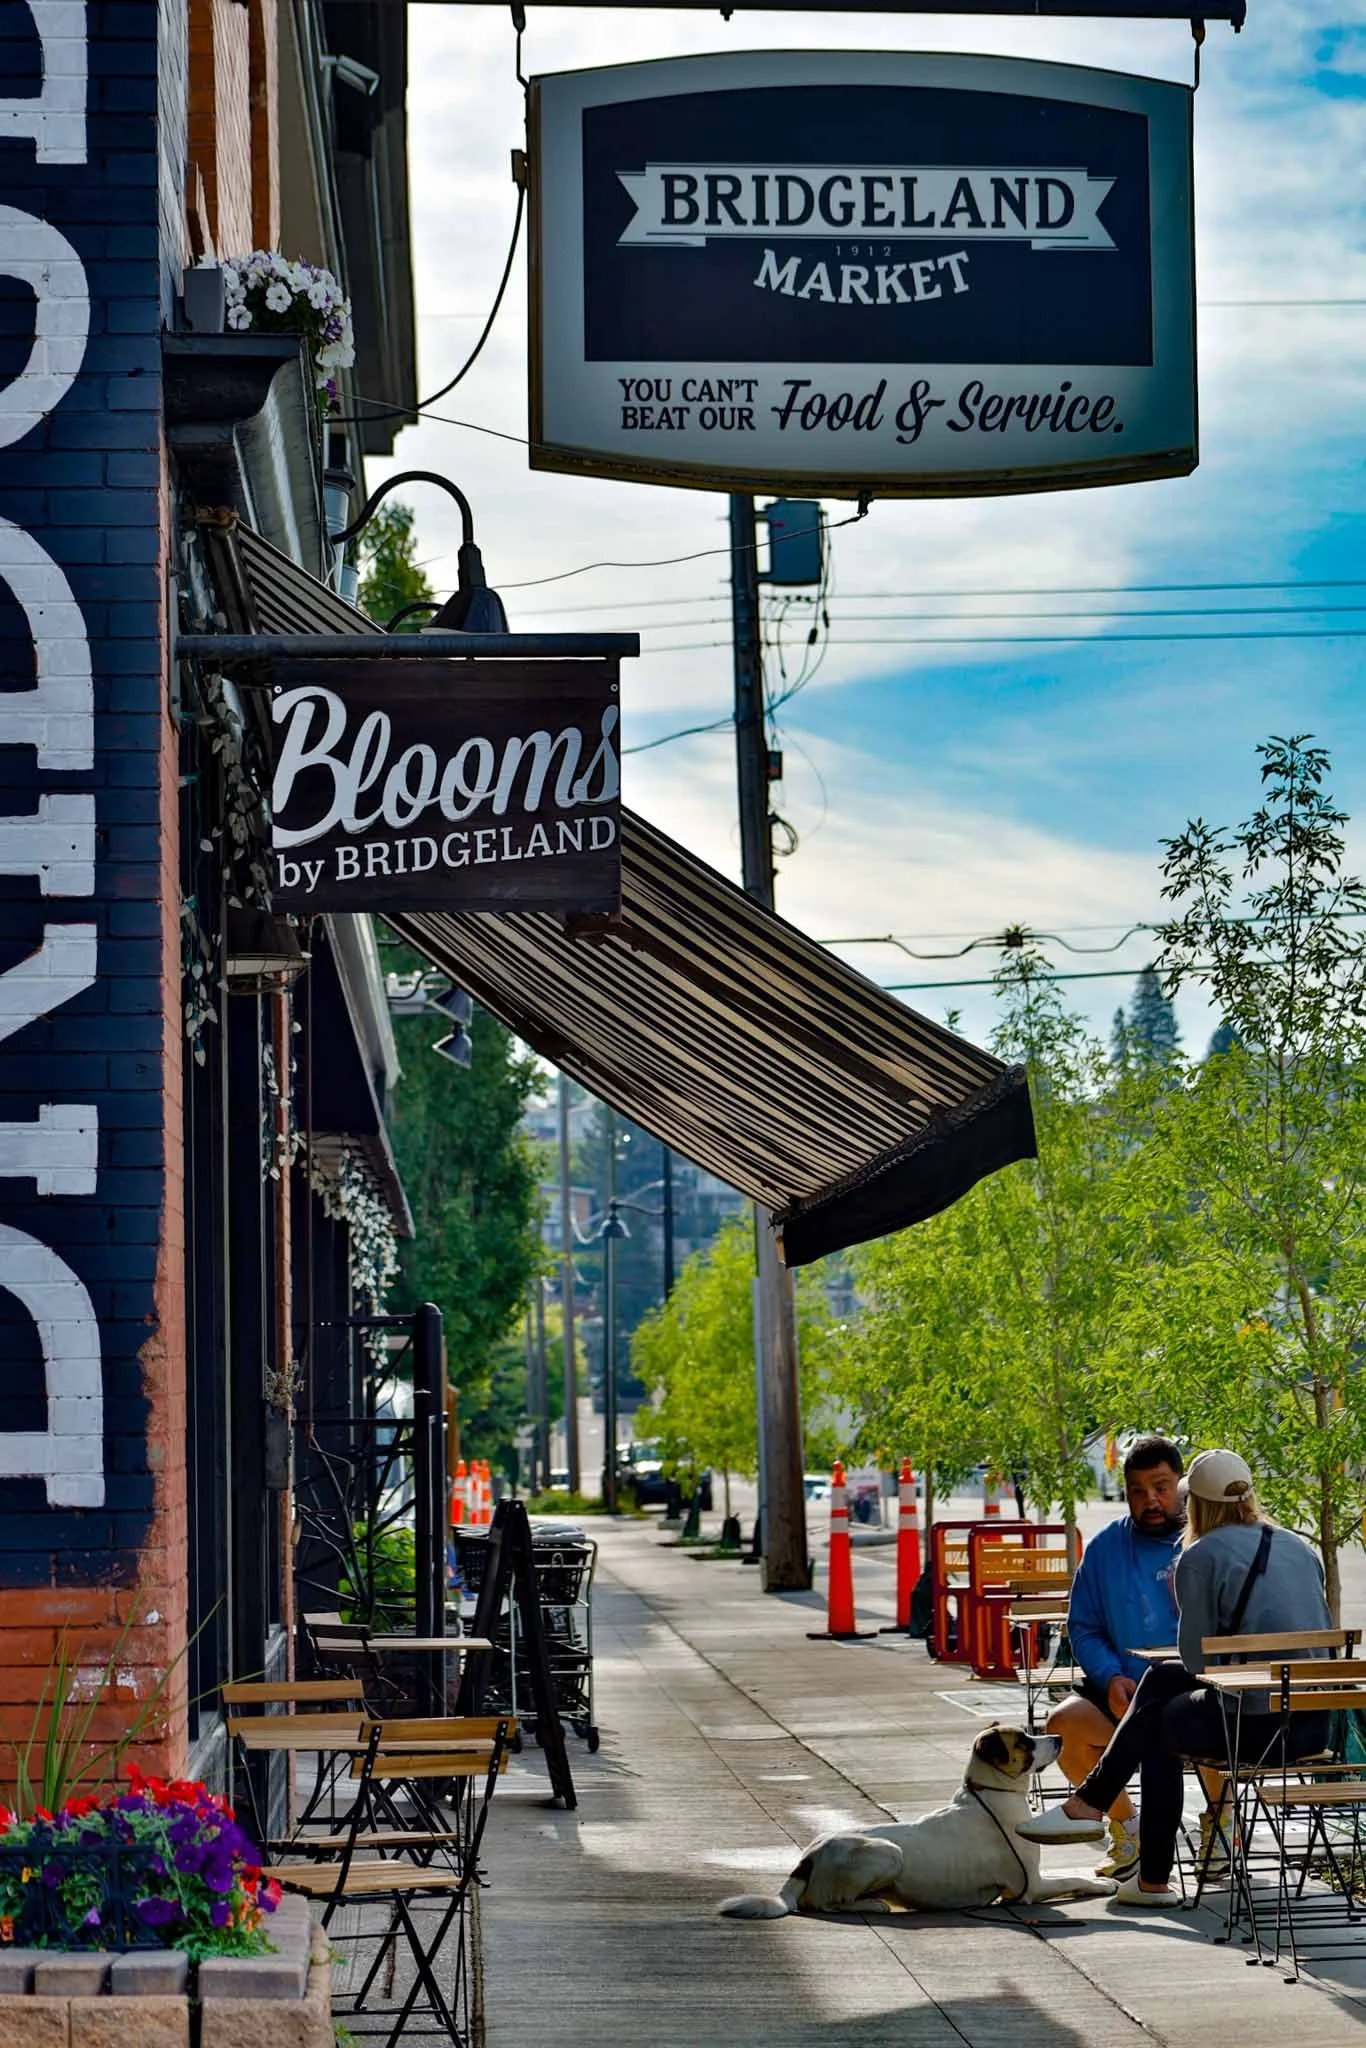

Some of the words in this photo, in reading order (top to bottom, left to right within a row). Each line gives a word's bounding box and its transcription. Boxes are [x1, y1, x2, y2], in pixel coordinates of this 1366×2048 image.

[660, 173, 1075, 230] BRIDGELAND
[753, 248, 971, 305] MARKET
[618, 378, 672, 402] YOU
[681, 379, 759, 402] CAN'T
[621, 406, 690, 430] BEAT
[699, 406, 756, 430] OUR
[771, 378, 888, 432] Food
[895, 379, 946, 445] &
[946, 379, 1124, 433] Service.
[271, 685, 620, 850] Blooms
[276, 854, 325, 894] by
[335, 815, 617, 882] BRIDGELAND
